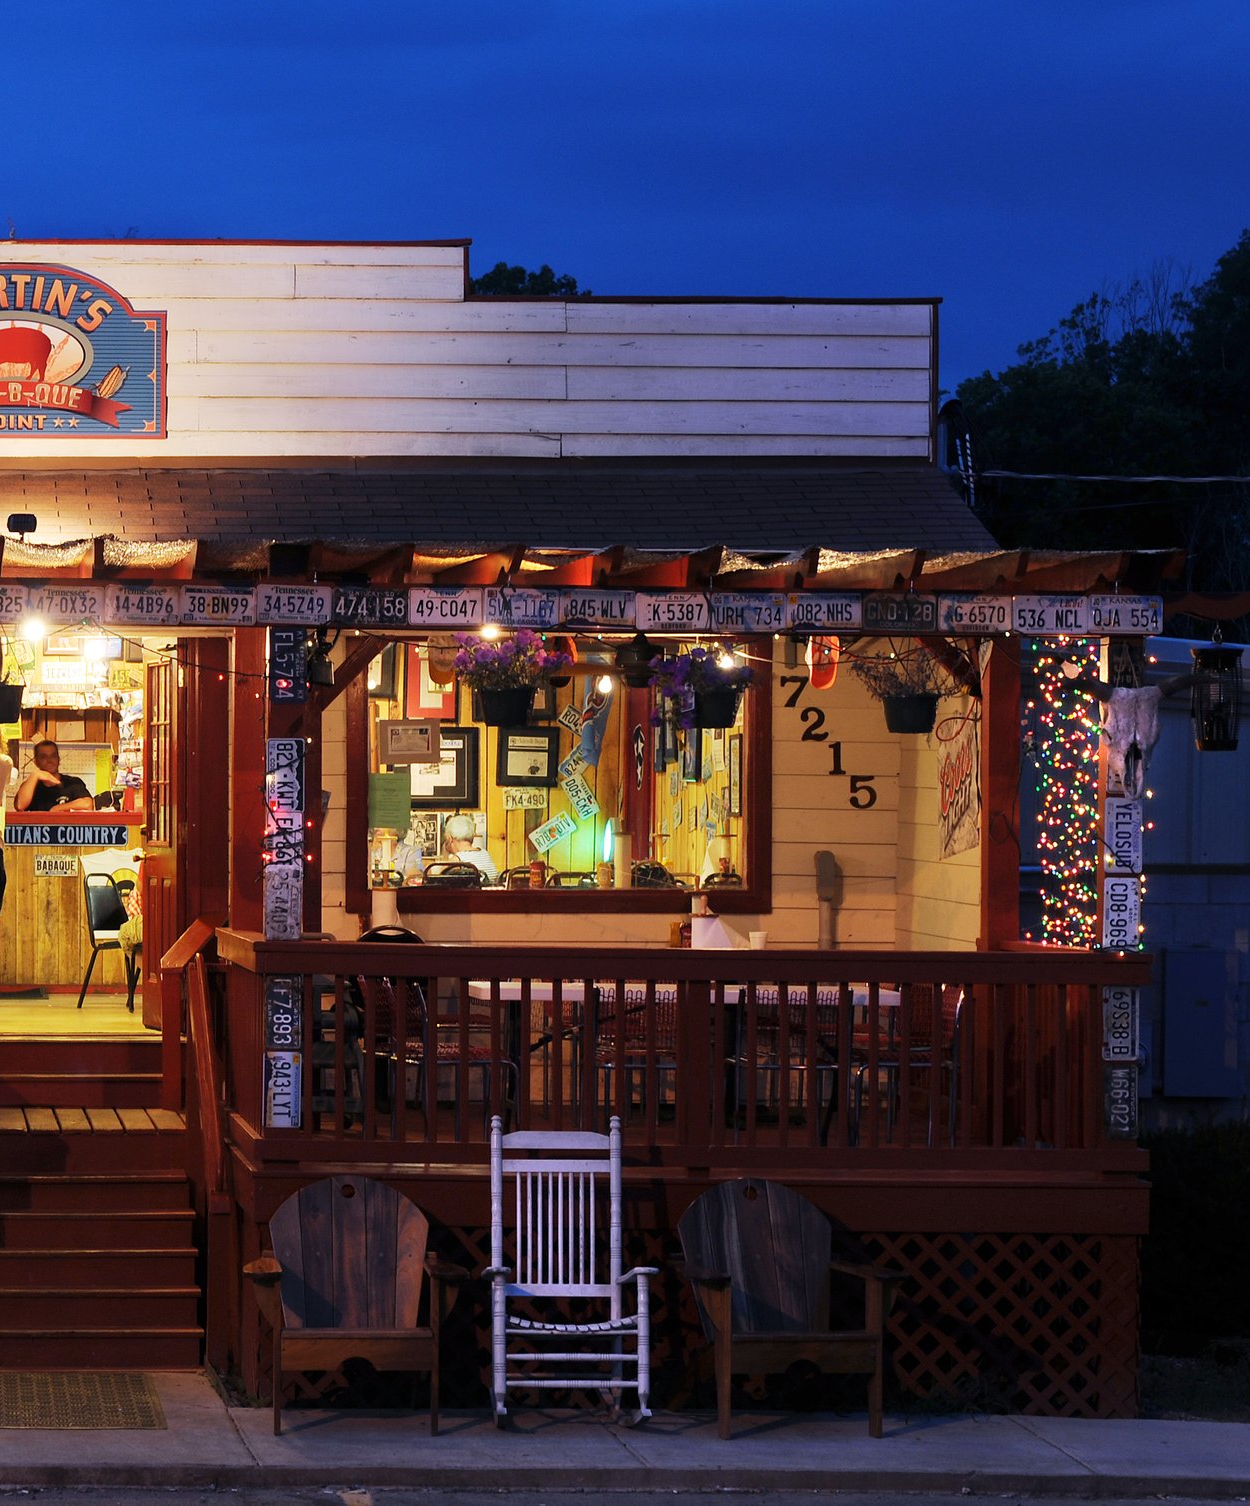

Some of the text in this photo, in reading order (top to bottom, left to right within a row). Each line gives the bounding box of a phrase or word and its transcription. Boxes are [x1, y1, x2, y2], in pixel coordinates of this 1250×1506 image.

[47, 588, 86, 597] Tennessee
[274, 586, 316, 596] Tennessee
[1109, 597, 1142, 605] KANSAS
[716, 607, 783, 625] URH 734
[1018, 609, 1046, 628] 536
[1055, 609, 1082, 628] NCL
[1131, 608, 1159, 628] 554
[57, 825, 119, 844] COUNTRY
[36, 860, 77, 871] BABAQUE
